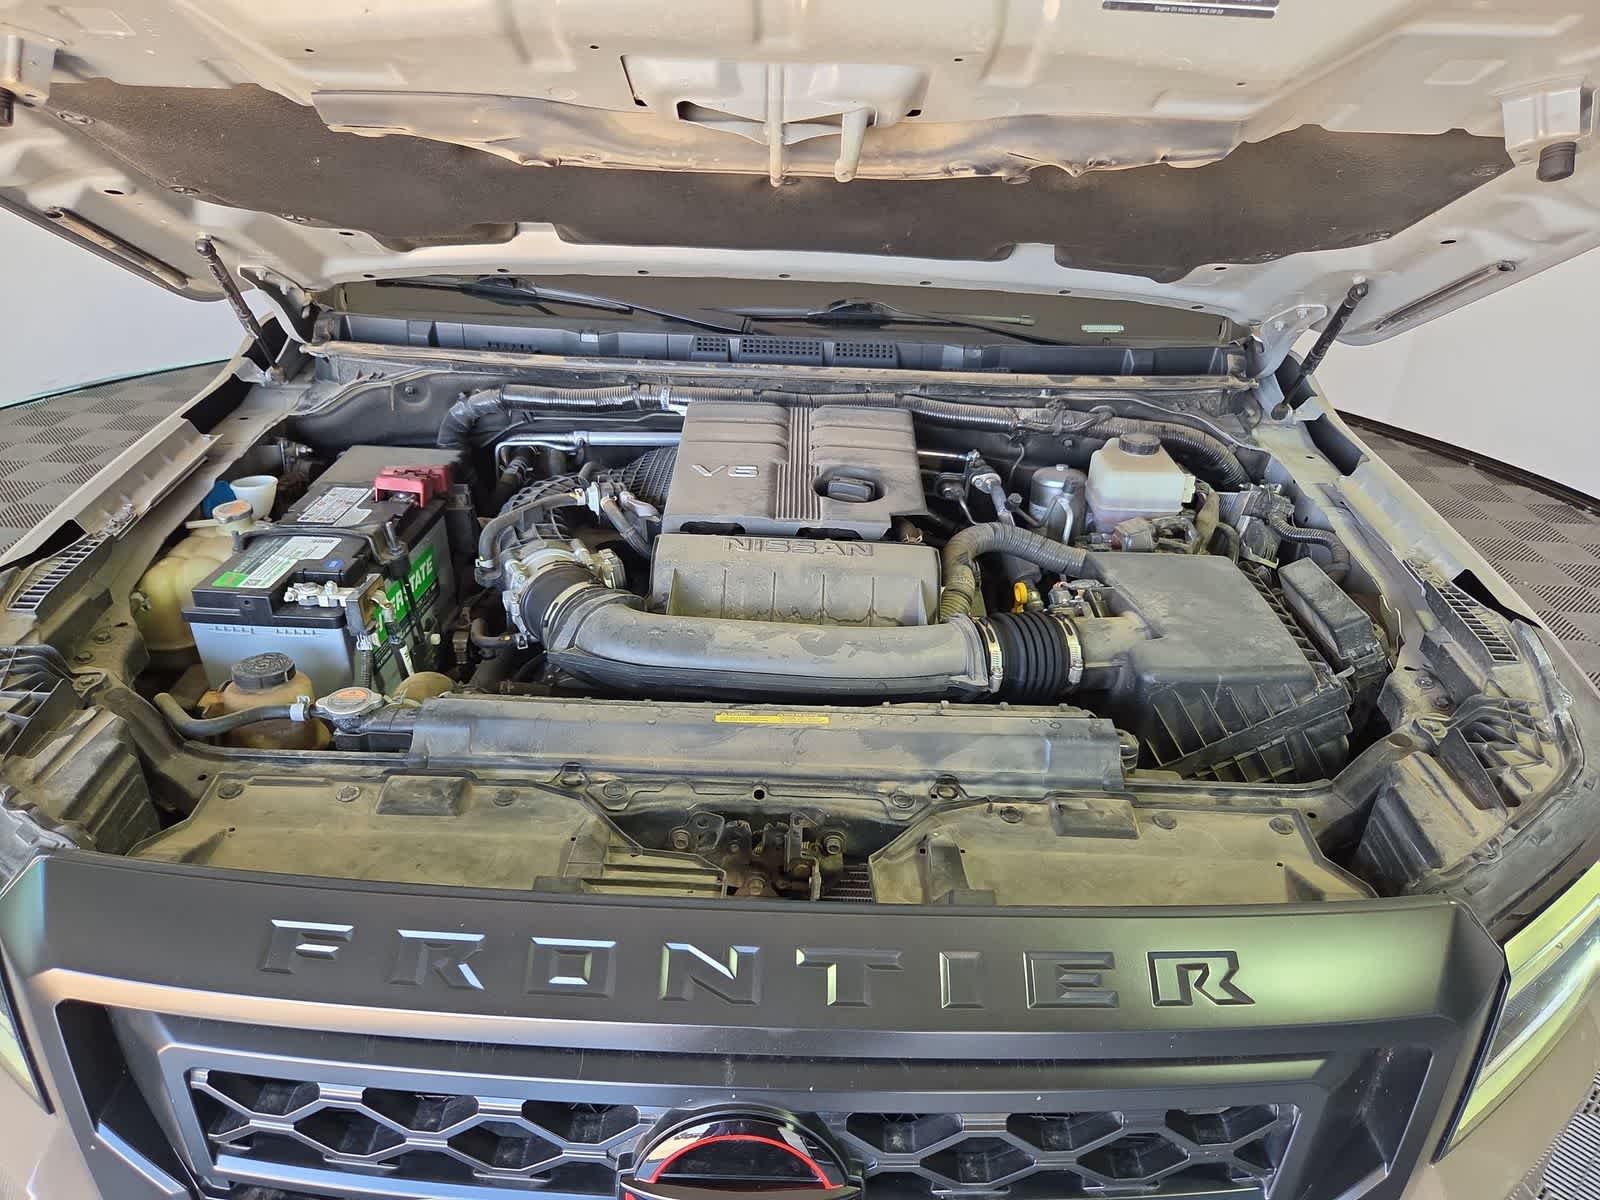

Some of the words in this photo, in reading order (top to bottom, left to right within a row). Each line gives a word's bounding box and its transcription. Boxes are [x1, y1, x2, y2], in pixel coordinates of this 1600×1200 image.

[690, 464, 760, 478] V6
[722, 536, 875, 557] NISSAN
[257, 917, 1256, 1009] FRONTIER
